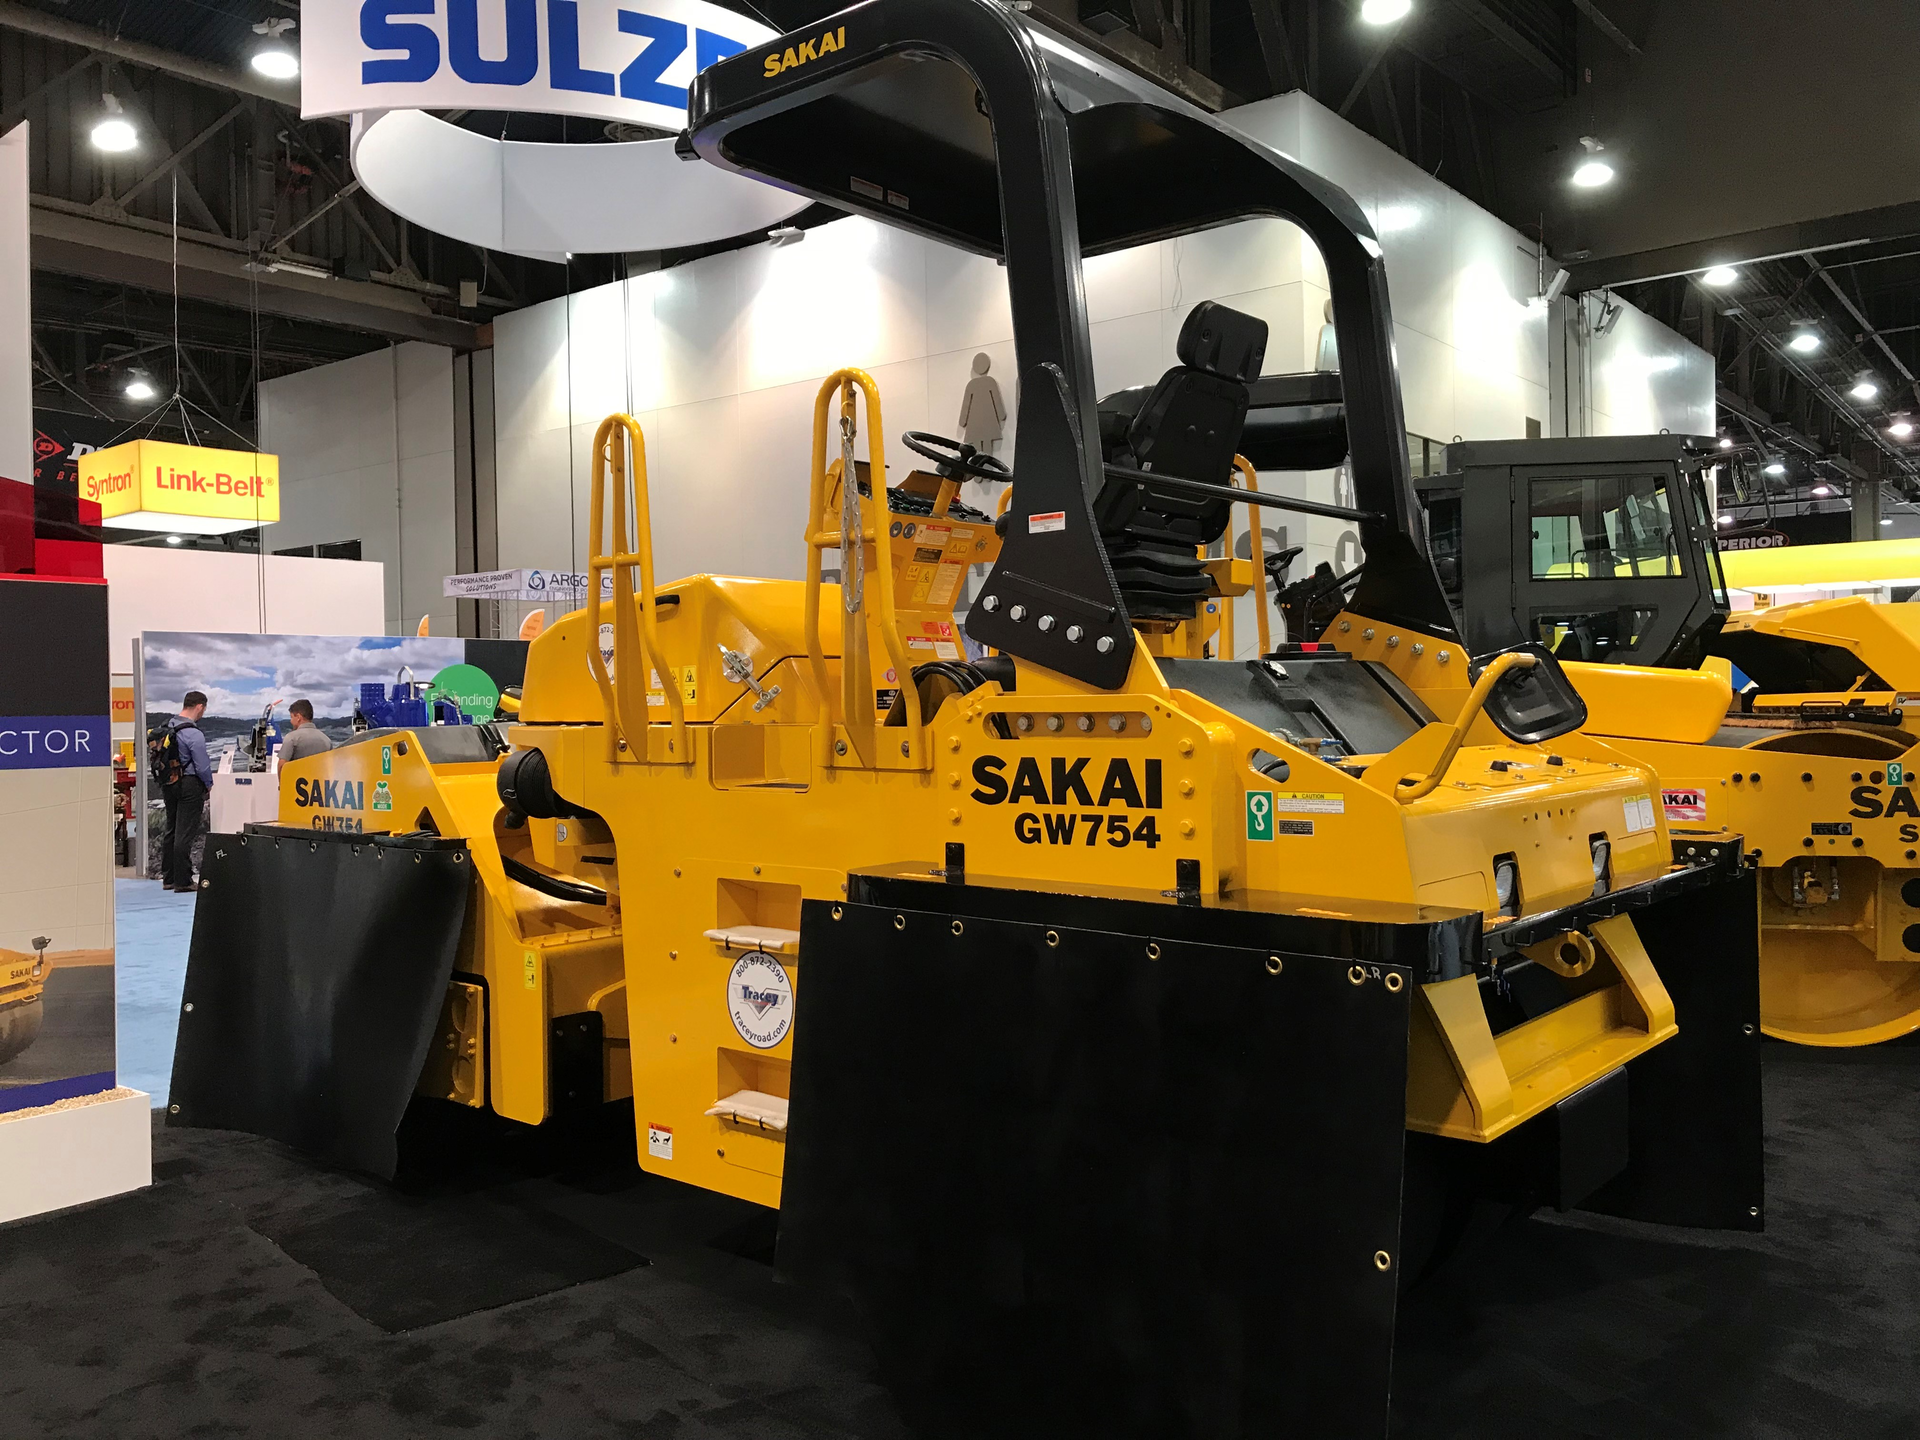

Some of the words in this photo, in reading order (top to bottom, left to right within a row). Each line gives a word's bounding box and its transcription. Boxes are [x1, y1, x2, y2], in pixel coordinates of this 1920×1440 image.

[763, 26, 846, 78] SAKAI
[450, 576, 490, 586] PERFORMANCE
[490, 573, 513, 582] PROVEN
[465, 583, 497, 592] SOLUTIONS
[0, 730, 91, 755] CTOR
[295, 777, 364, 811] SAKAI
[970, 755, 1163, 809] SAKAI
[1848, 785, 1920, 819] SA
[1014, 812, 1161, 849] GW754
[10, 967, 31, 980] SAKAI
[735, 955, 784, 984] 800-872-2390
[741, 985, 779, 1007] Tracey
[734, 1010, 787, 1043] traceyroad.com
